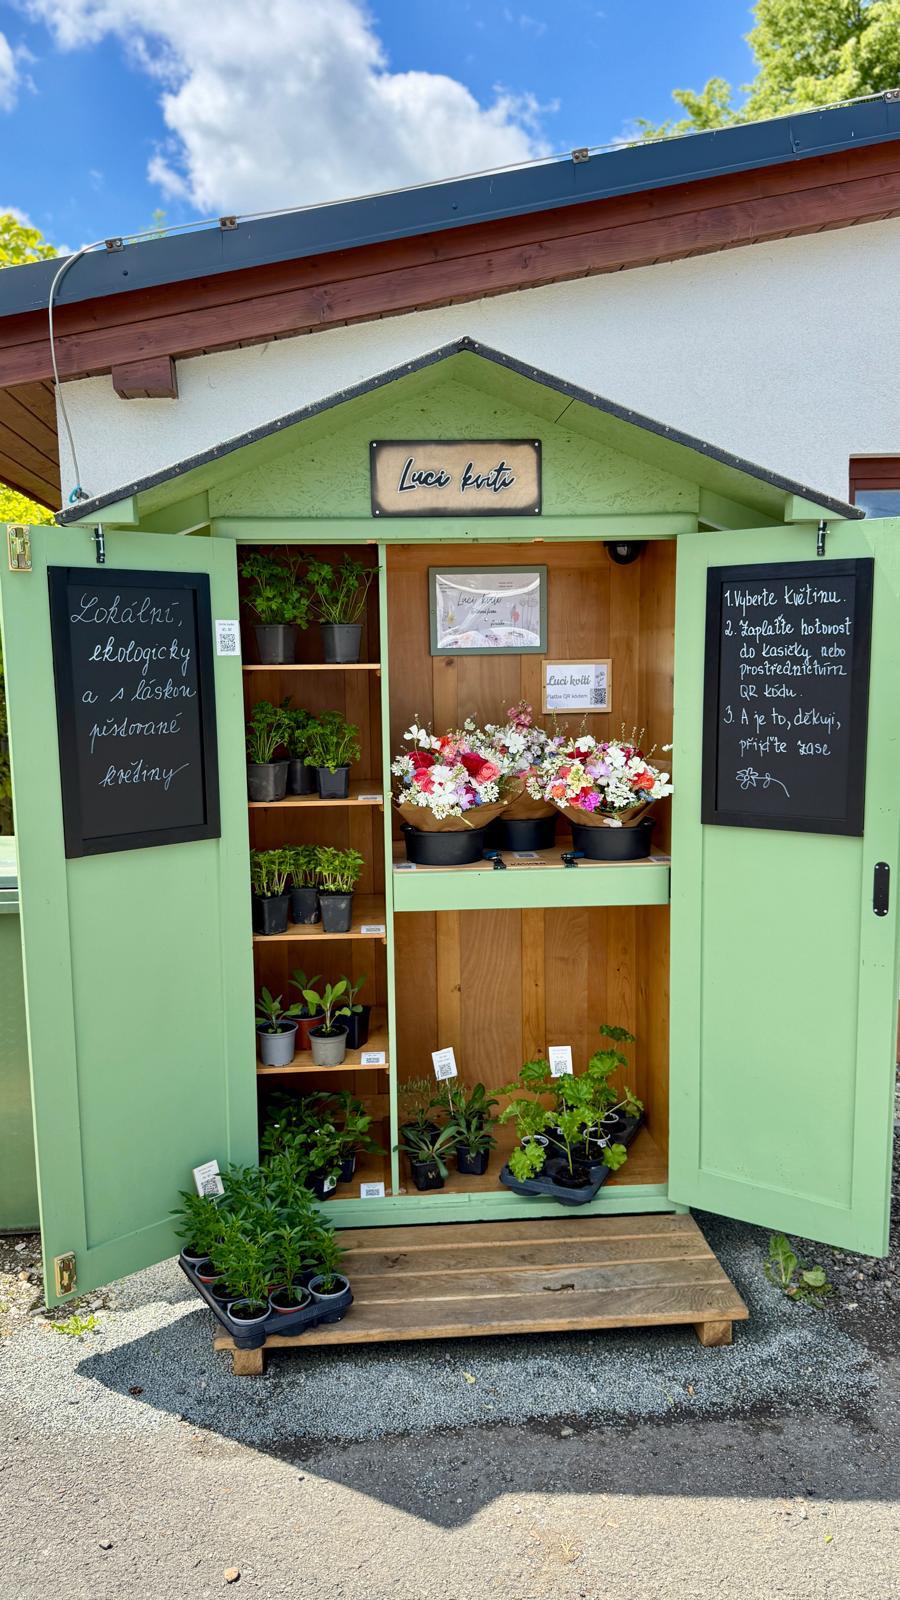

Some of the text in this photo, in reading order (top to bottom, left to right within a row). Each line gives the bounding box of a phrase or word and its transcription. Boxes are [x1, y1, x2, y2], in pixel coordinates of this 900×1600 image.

[398, 457, 452, 493] Luci
[70, 593, 182, 627] Lokální,
[724, 614, 852, 644] 2. Zaplaťte hotovost
[88, 636, 191, 677] ekologicky
[739, 642, 846, 664] do kasičky nebo
[546, 675, 568, 686] Luci
[739, 659, 847, 681] prostřednictvím
[82, 678, 196, 704] a s láskou
[740, 684, 758, 701] QR
[89, 712, 183, 754] pěstované
[723, 705, 841, 734] 3. A je to, děkuji,
[797, 740, 831, 756] zase
[98, 759, 190, 791] květiny
